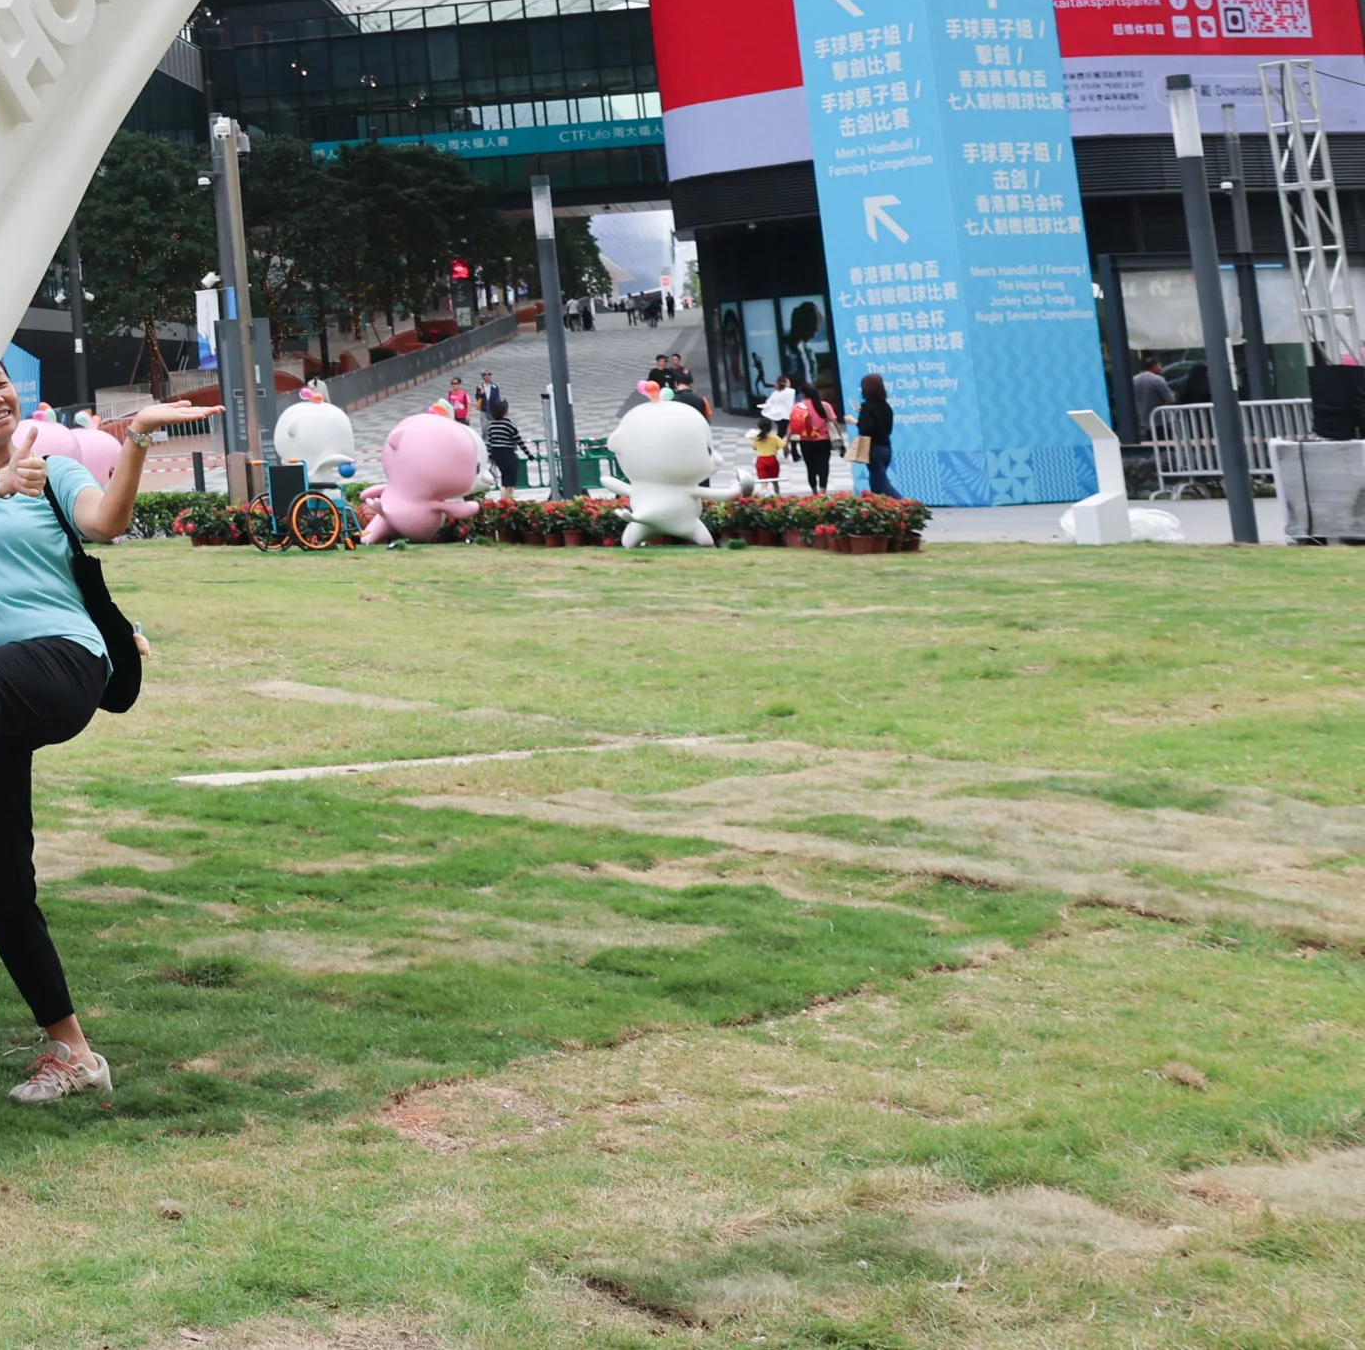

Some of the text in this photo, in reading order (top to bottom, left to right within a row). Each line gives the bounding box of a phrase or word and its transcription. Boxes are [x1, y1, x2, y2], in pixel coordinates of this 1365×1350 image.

[814, 24, 902, 59] 手球男子組
[612, 124, 664, 138] 周大福人
[869, 139, 913, 155] Handball
[829, 154, 933, 177] Fencing Competition
[998, 265, 1038, 276] Handball
[1046, 265, 1081, 276] Fencing
[998, 280, 1065, 291] The Hong Kong
[1039, 308, 1094, 321] Competition
[866, 361, 945, 375] The Hong Kong
[896, 377, 919, 389] Club
[922, 376, 959, 390] Trophy
[908, 394, 947, 406] Sevens
